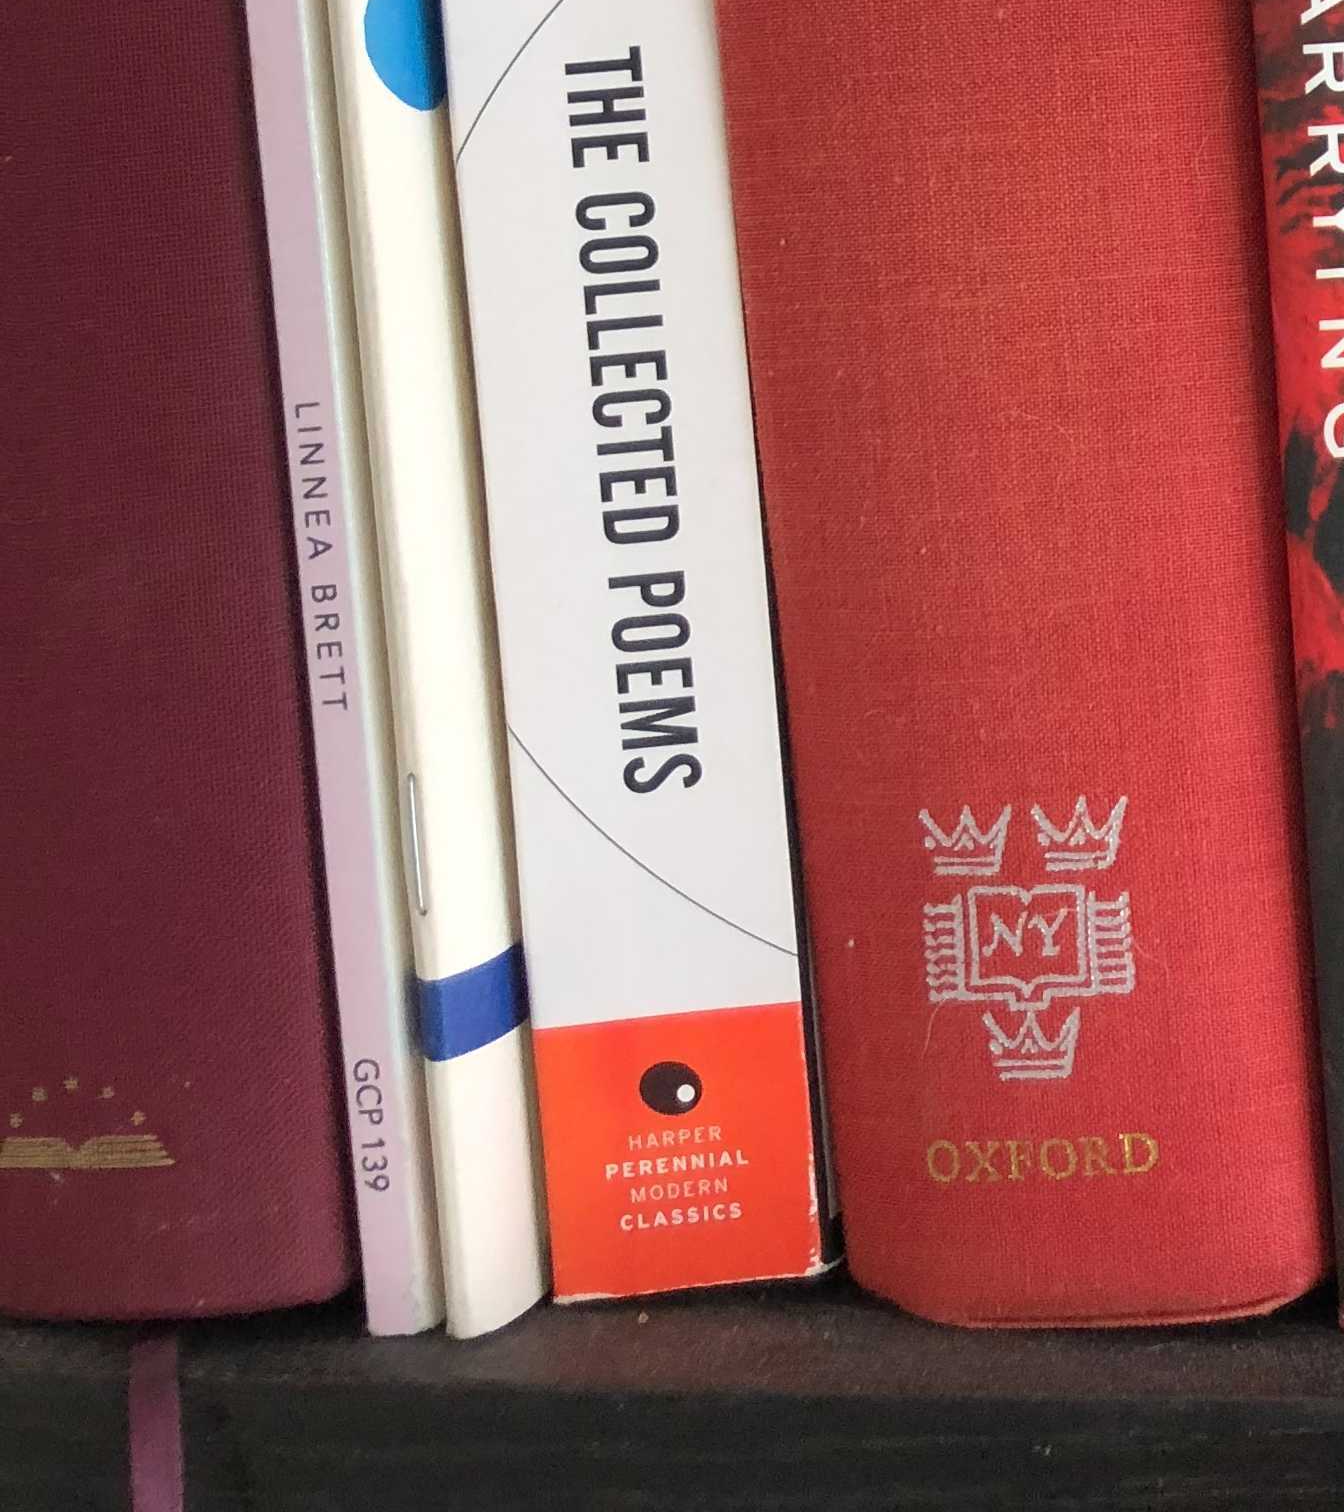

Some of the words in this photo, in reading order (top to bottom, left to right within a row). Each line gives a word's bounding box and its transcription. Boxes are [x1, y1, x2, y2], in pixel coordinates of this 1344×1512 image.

[564, 46, 651, 169] THE
[574, 190, 681, 546] COLLECTED
[294, 400, 332, 560] LINNEA
[311, 583, 348, 712] BRETT
[607, 570, 701, 794] POEMS
[352, 1057, 383, 1127] GCP
[361, 1136, 390, 1193] 139
[604, 1149, 749, 1179] PERENNIAL
[628, 1126, 722, 1152] HARPER
[926, 1131, 1160, 1184] OXFORD
[619, 1201, 742, 1231] CLASSICS
[629, 1177, 728, 1204] MODERN
